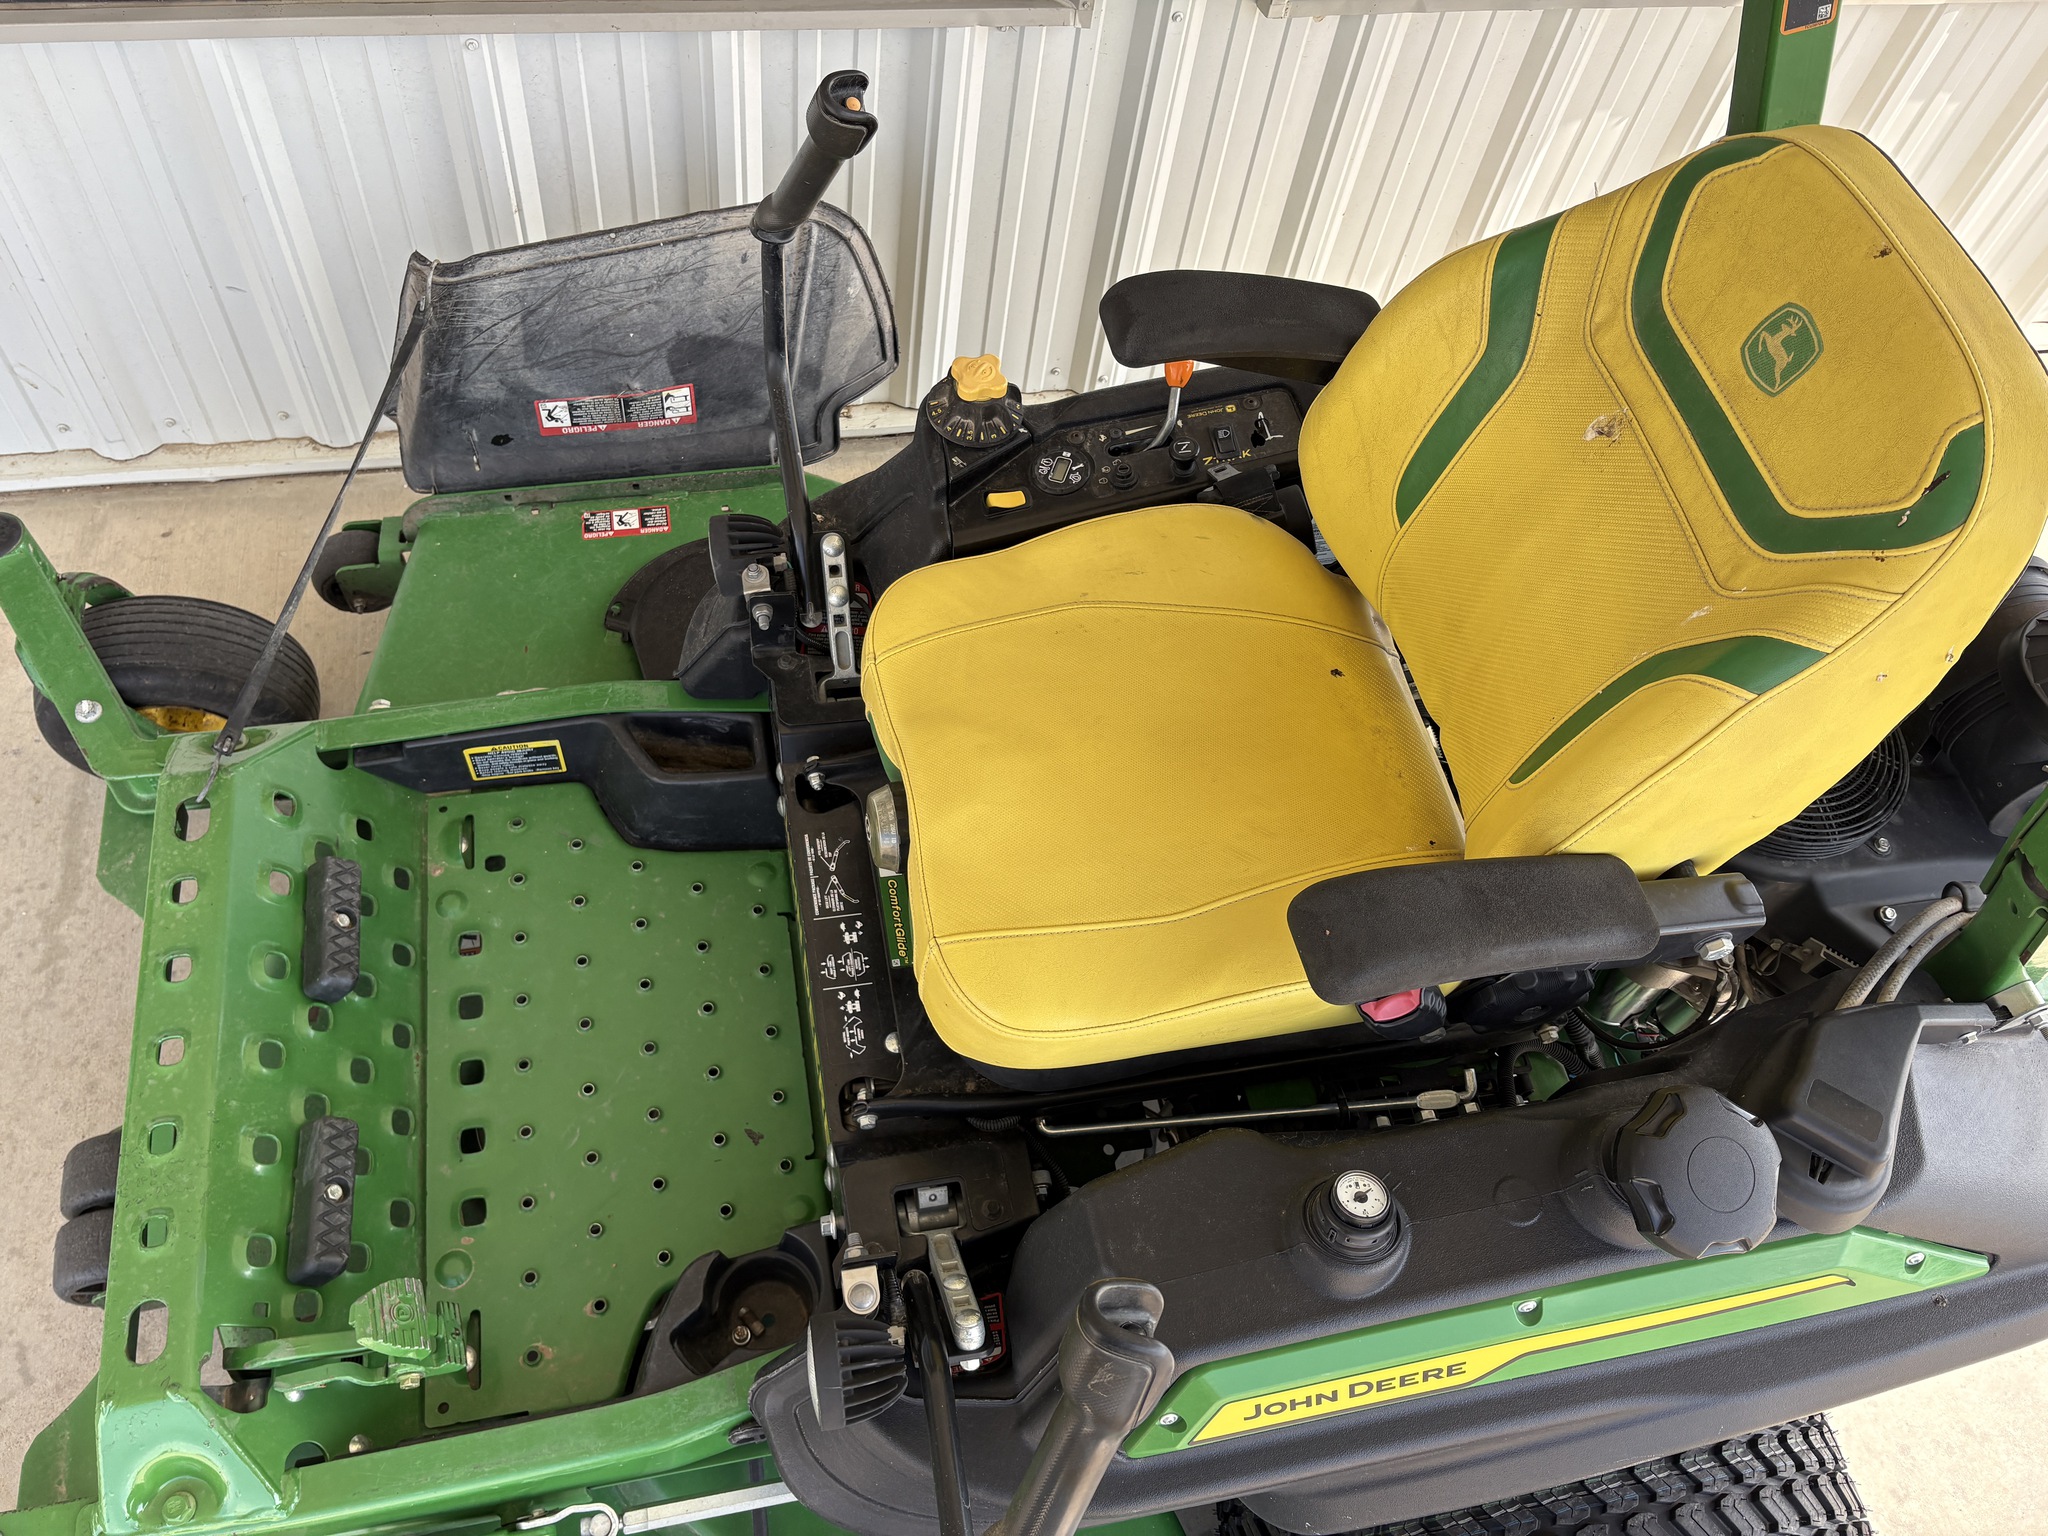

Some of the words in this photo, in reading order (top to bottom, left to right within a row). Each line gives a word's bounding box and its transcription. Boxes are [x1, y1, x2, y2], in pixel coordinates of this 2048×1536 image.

[638, 419, 671, 428] DANGER
[562, 425, 597, 434] PELIGRO
[1243, 1390, 1338, 1421] JOHN
[1348, 1361, 1467, 1399] DEERE
